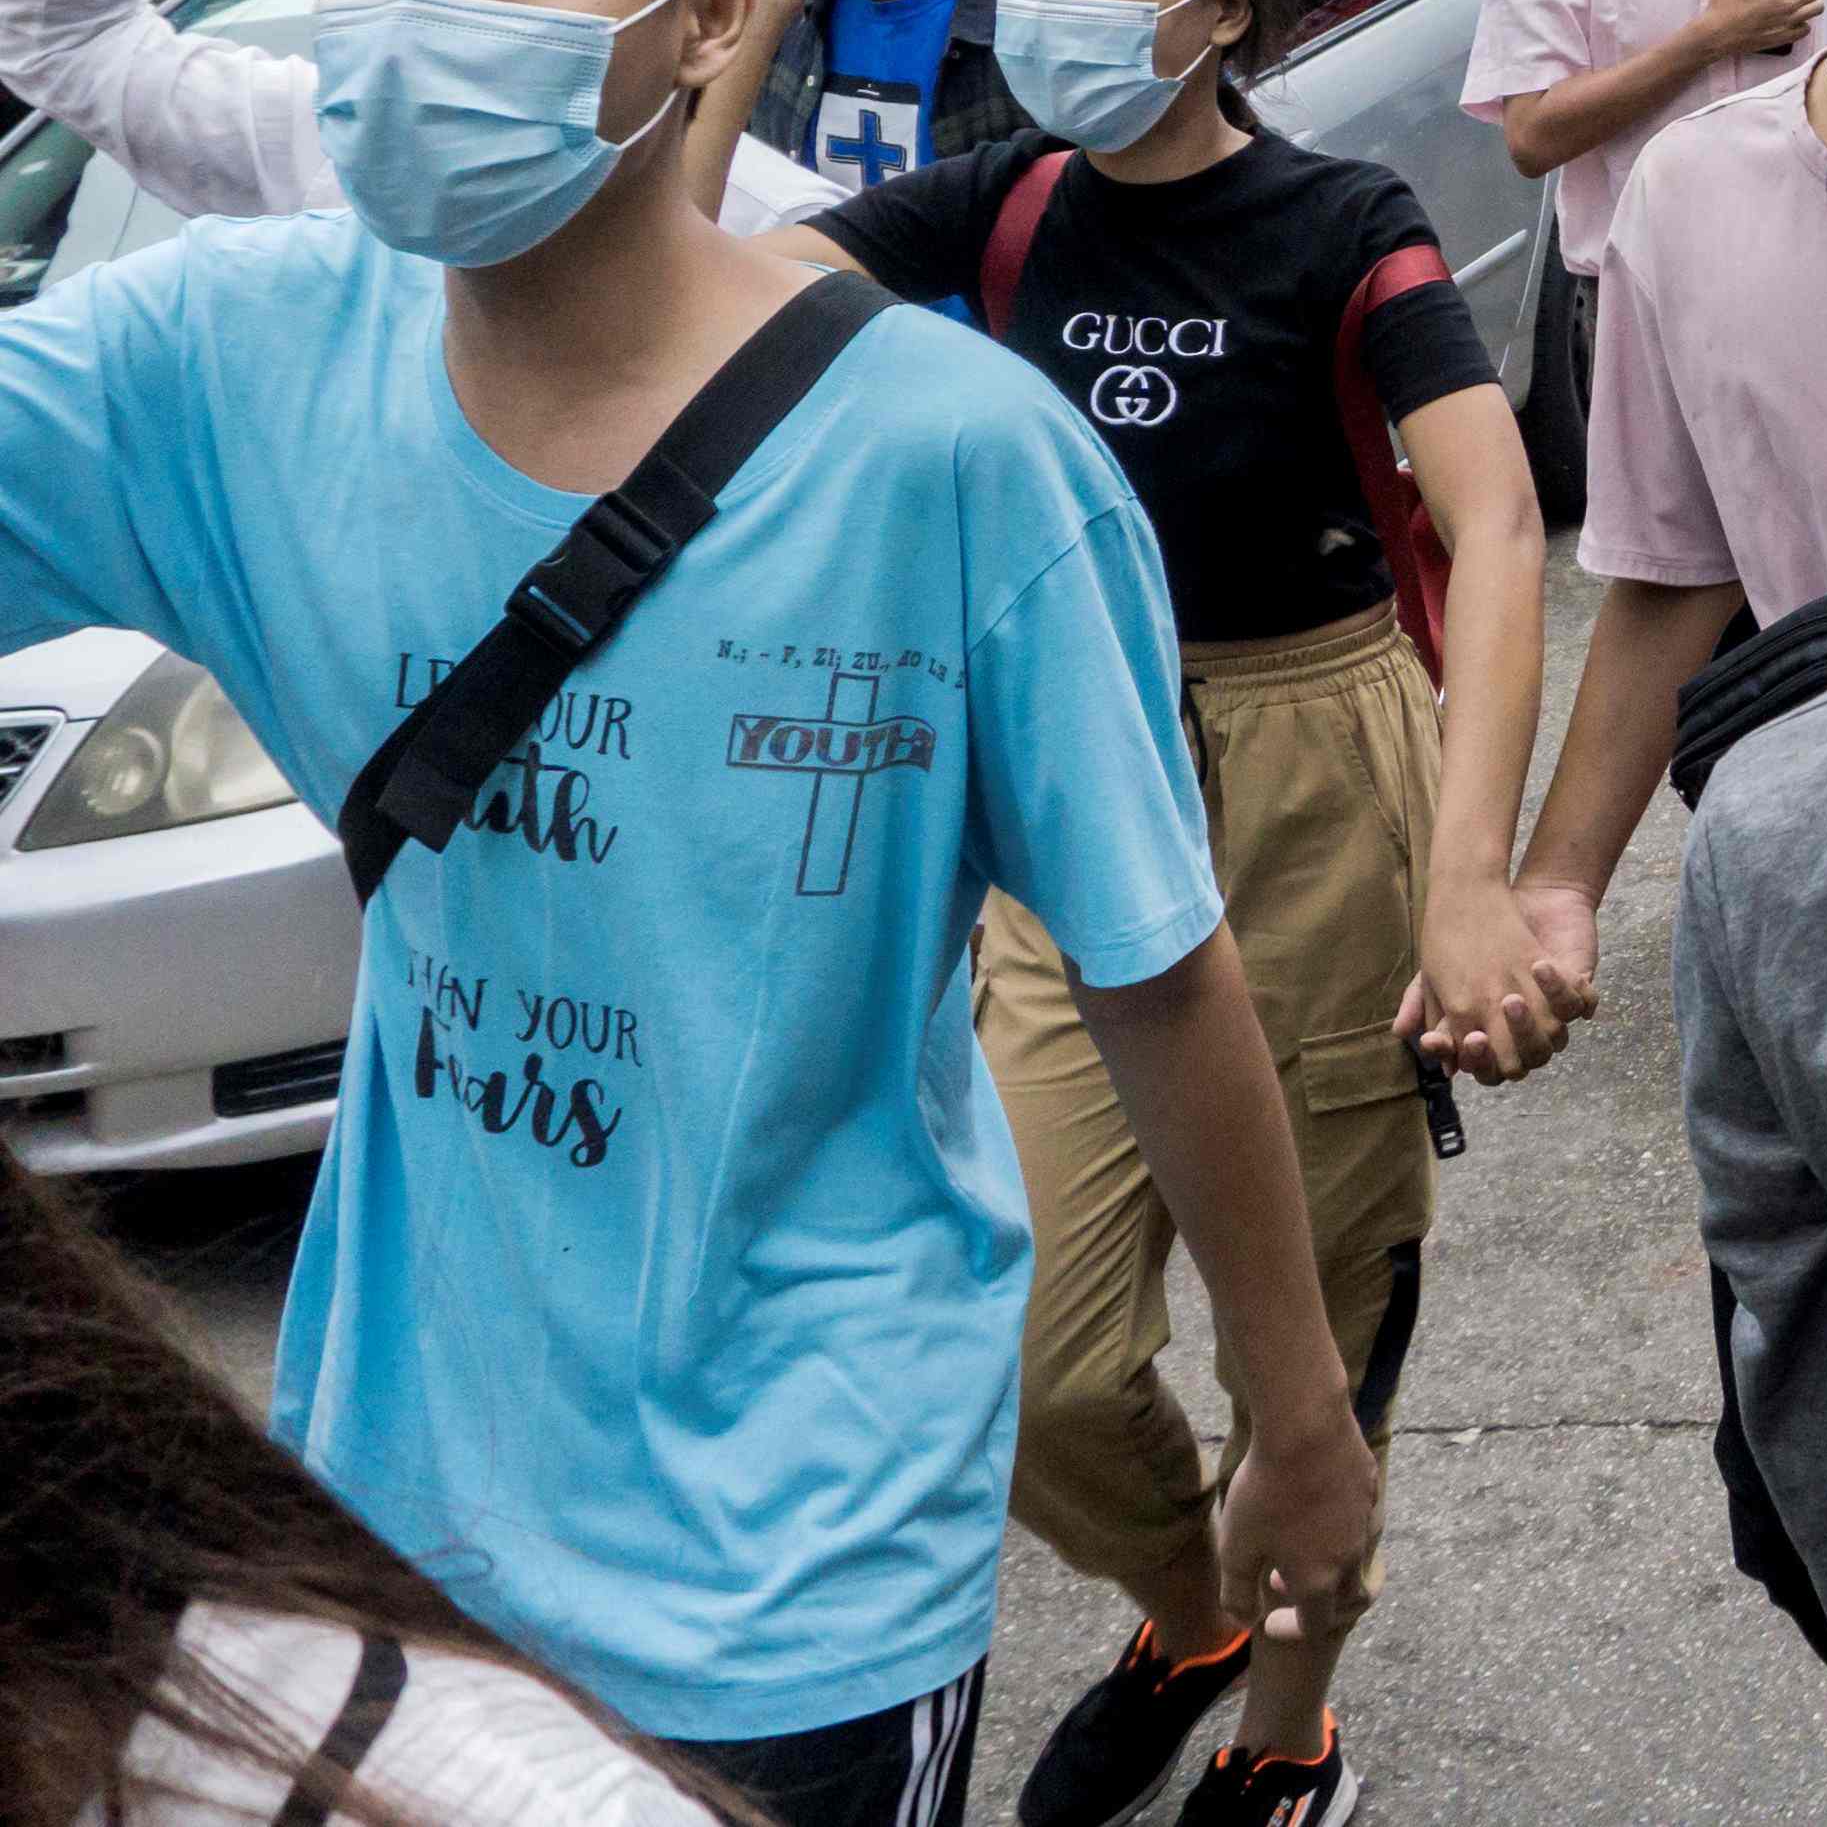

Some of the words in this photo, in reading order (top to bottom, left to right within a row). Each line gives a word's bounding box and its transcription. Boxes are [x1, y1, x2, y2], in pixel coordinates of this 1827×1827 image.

[1062, 310, 1228, 358] GUCCI
[537, 687, 634, 760] OUR
[734, 717, 932, 772] YOUTH
[515, 988, 643, 1069] YOUR
